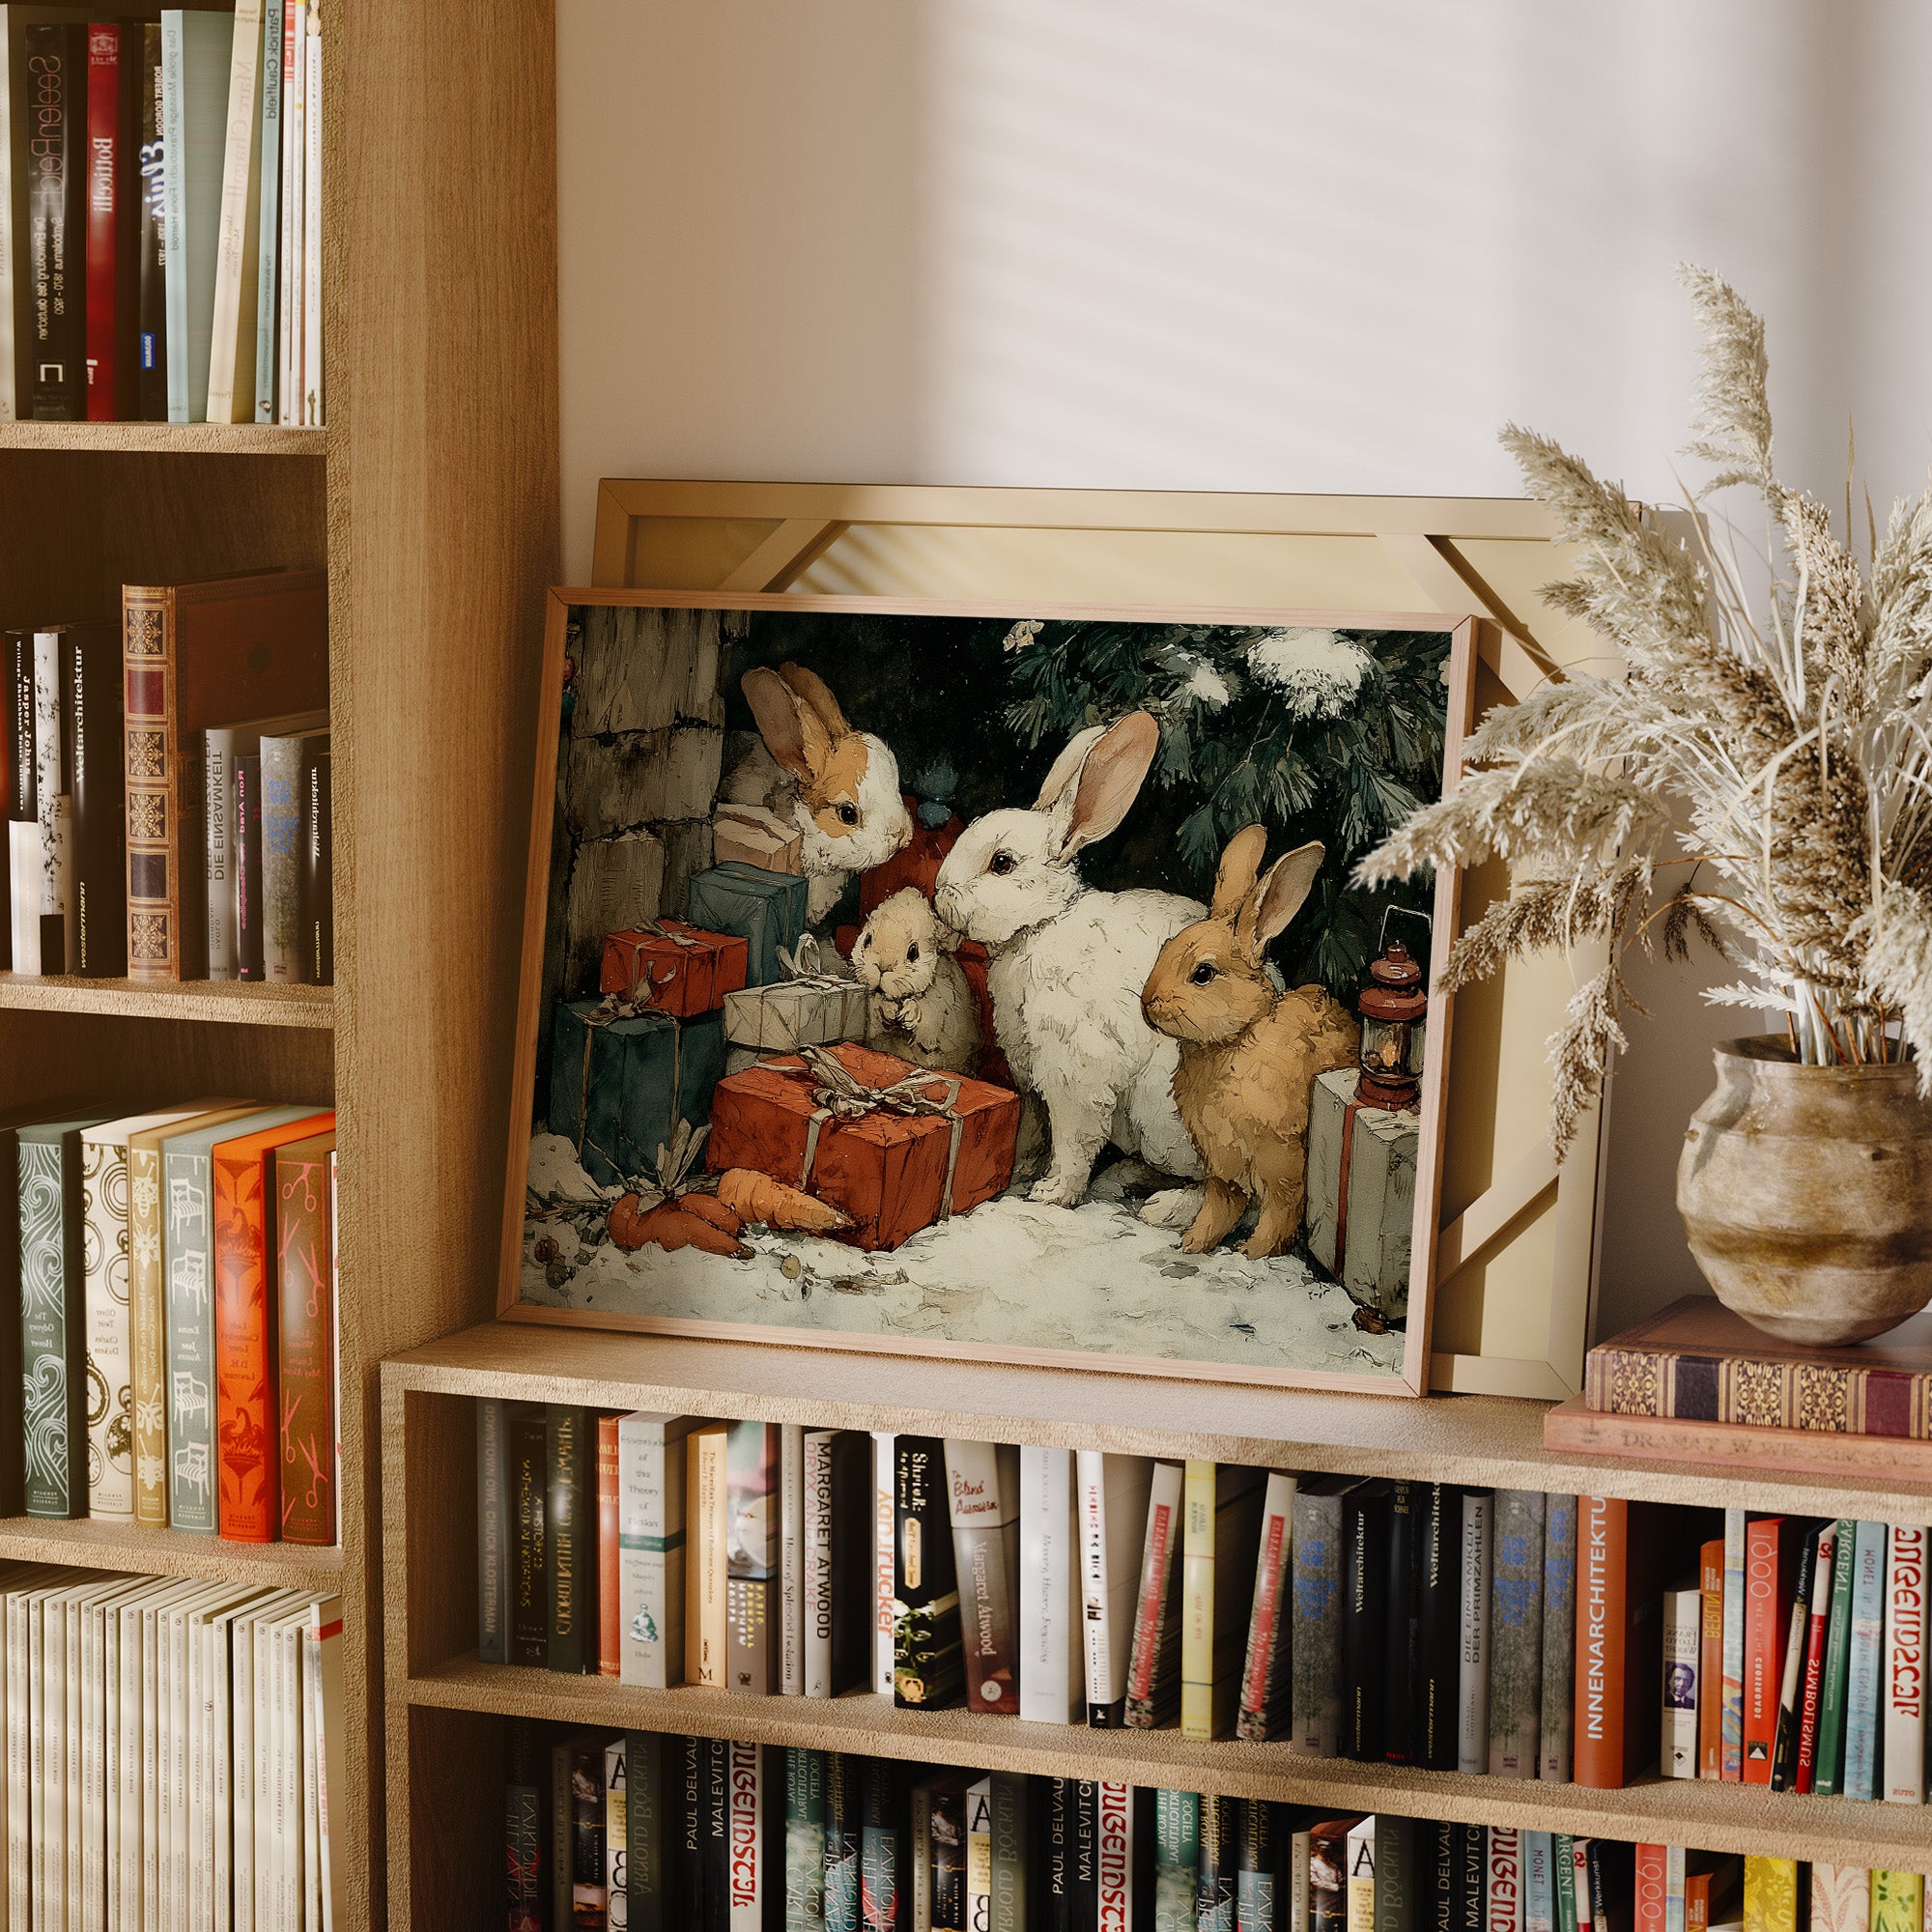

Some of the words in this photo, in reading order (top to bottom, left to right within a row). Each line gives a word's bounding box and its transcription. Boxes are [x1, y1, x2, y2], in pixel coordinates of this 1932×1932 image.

[22, 675, 31, 726] Jasper
[73, 646, 85, 783] Weltarchitektur
[24, 730, 33, 776] Johns
[484, 1405, 496, 1476] DOWNTOWN
[1731, 1438, 1753, 1455] W
[485, 1477, 496, 1505] OWL
[629, 1485, 658, 1497] Theory
[805, 1440, 817, 1508] ORYX
[817, 1441, 831, 1553] MARGARET
[953, 1480, 984, 1497] Blind
[486, 1510, 497, 1551] CHUCK
[805, 1512, 816, 1548] AND
[806, 1551, 816, 1612] CRAKE
[972, 1535, 990, 1601] Margaret
[1354, 1511, 1365, 1614] Weltarchitektur
[1464, 1520, 1474, 1629] EINSAMKEIT
[1473, 1506, 1483, 1622] PRIMZAHLEN
[485, 1554, 497, 1634] KLOSTERMAN
[783, 1585, 794, 1633] Splendid
[816, 1555, 831, 1638] ATWOOD
[877, 1550, 895, 1638] rucker
[977, 1604, 997, 1656] Atwood
[1472, 1628, 1481, 1664] DER
[1892, 1526, 1922, 1718] JUGENDSTIL
[698, 1666, 713, 1682] M
[785, 1634, 794, 1681] Isolation
[1427, 1678, 1435, 1759] westermann
[686, 1738, 697, 1803] DELVAU
[686, 1807, 697, 1851] PAUL
[1052, 1777, 1064, 1845] DELVAU
[1052, 1851, 1064, 1894] PAUL
[1351, 1839, 1375, 1879] A
[1438, 1822, 1450, 1890] DELVAU
[1533, 1849, 1544, 1884] MONET
[1574, 1851, 1585, 1868] 2
[1533, 1891, 1544, 1902] IN
[1591, 1861, 1604, 1908] Werkkunst
[1635, 1855, 1662, 1919] 1900
